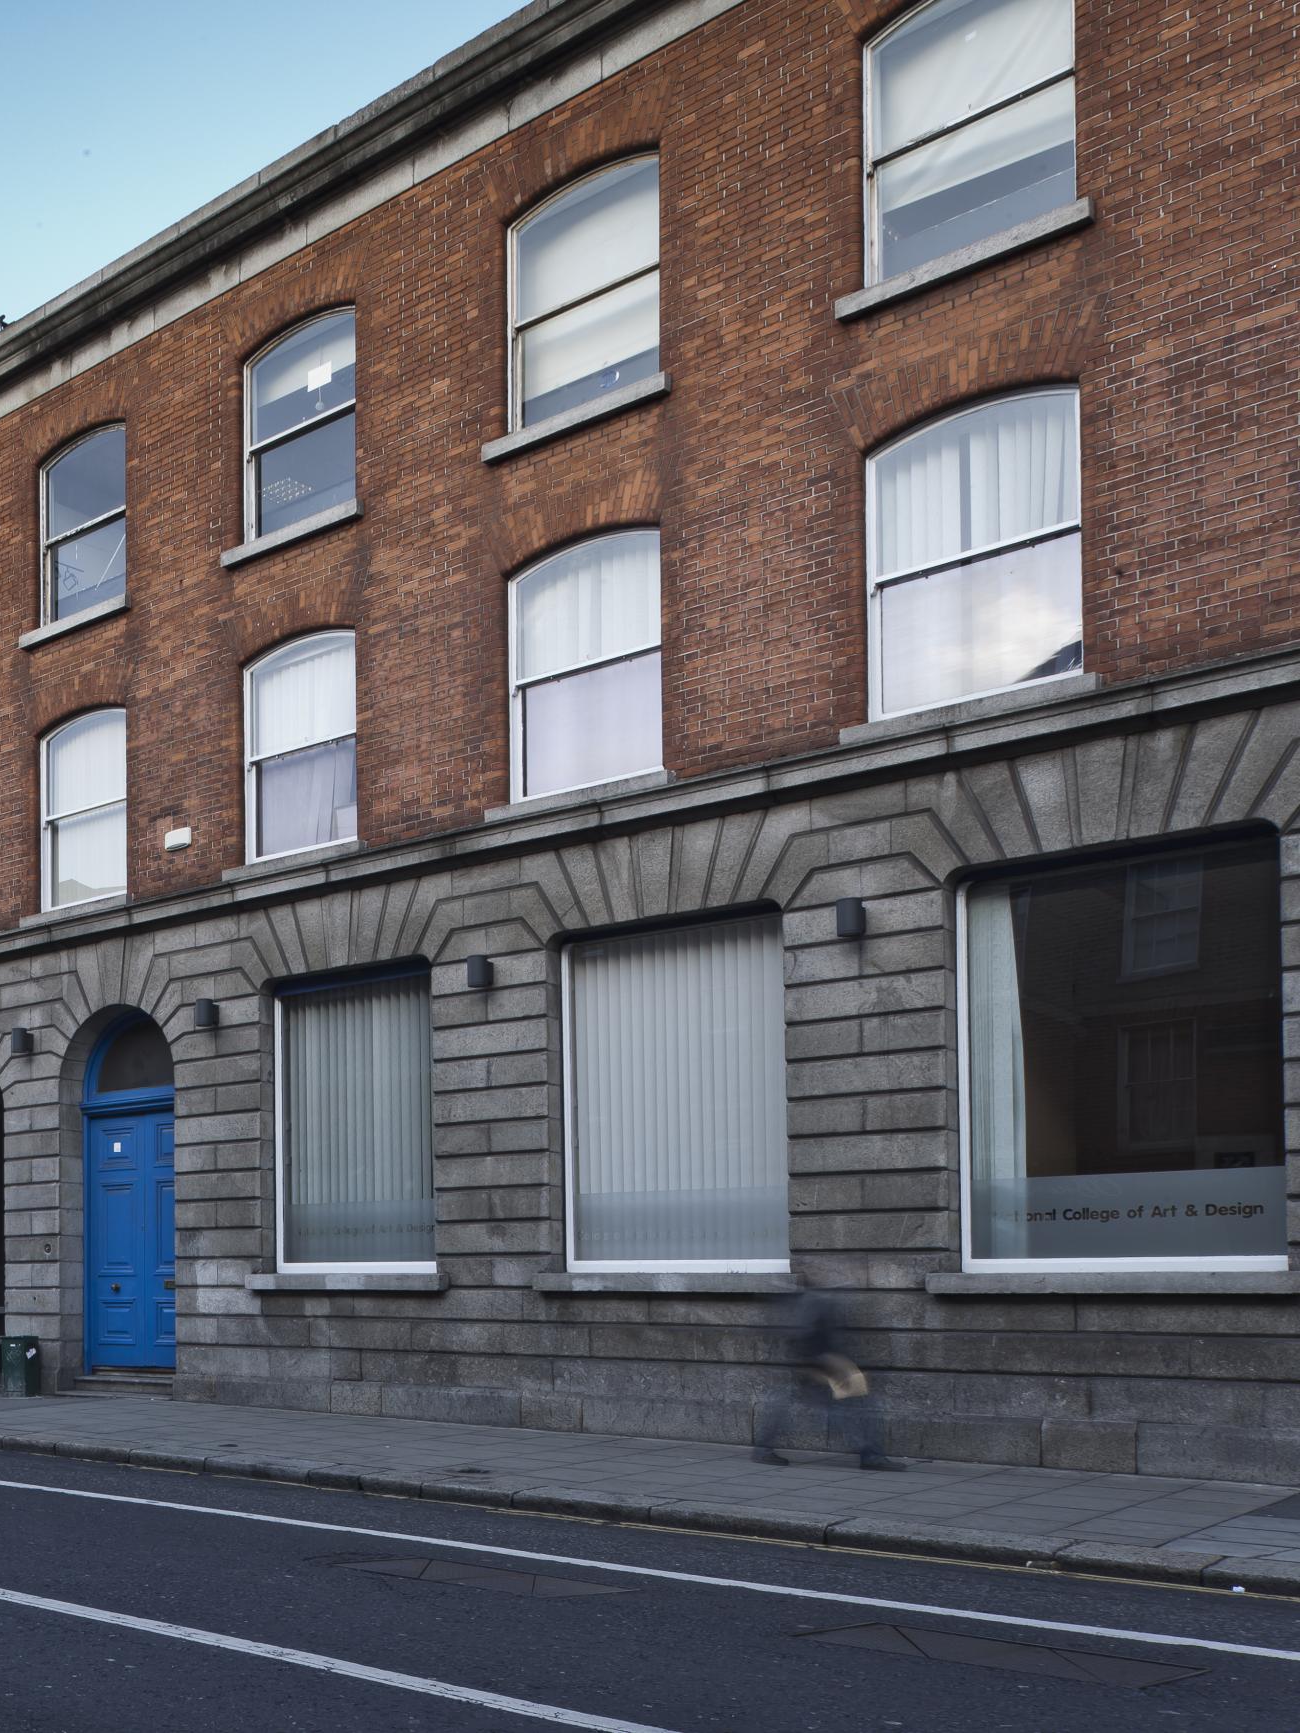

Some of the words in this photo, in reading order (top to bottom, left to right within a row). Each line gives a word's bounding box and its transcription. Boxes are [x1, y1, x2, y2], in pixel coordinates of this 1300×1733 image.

[1061, 1206, 1120, 1223] College
[1126, 1205, 1144, 1219] of
[1151, 1204, 1178, 1219] Art
[1184, 1203, 1198, 1218] &
[1204, 1202, 1264, 1220] Design
